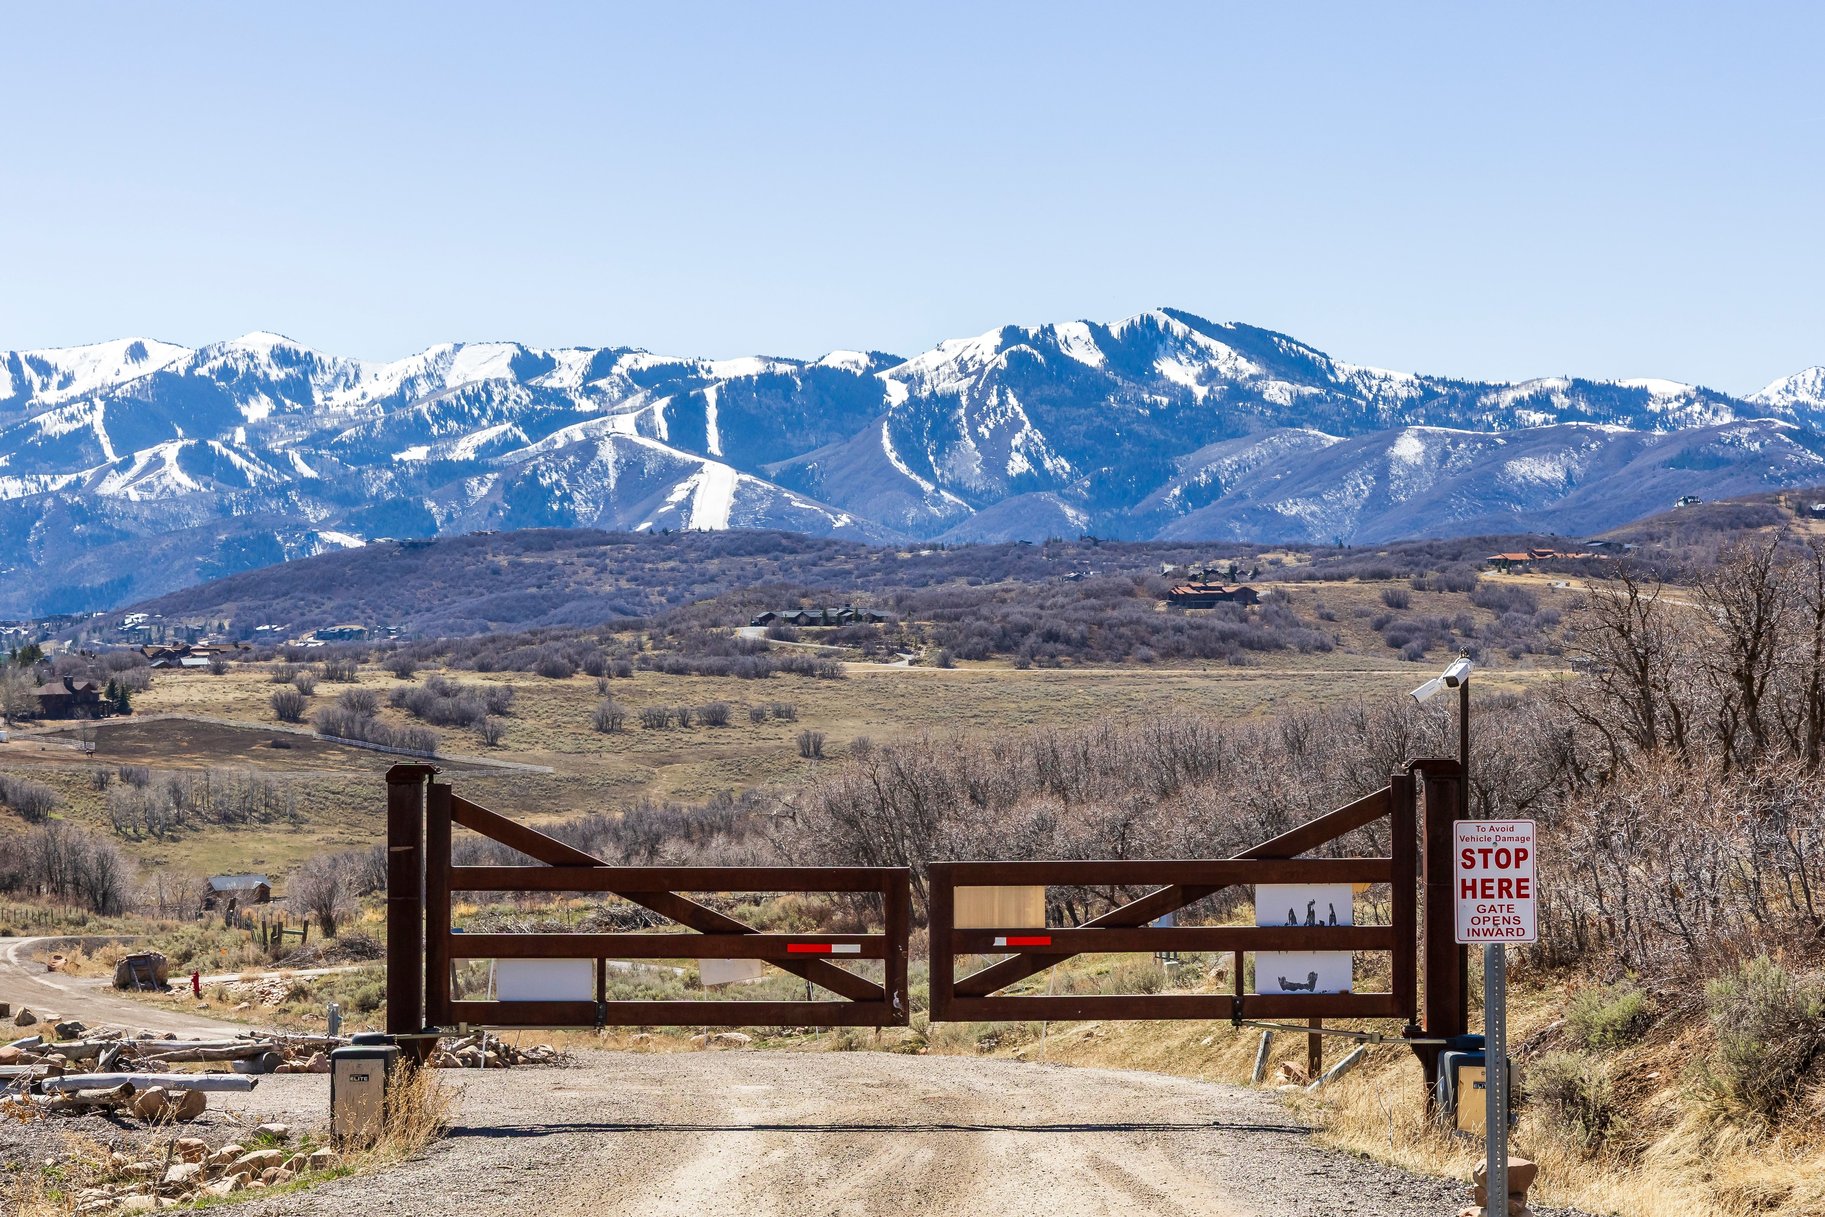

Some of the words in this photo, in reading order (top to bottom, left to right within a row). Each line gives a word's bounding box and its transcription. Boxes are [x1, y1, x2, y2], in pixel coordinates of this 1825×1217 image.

[1495, 834, 1531, 843] Damage
[1461, 848, 1528, 869] STOP
[1461, 878, 1530, 899] HERE
[1476, 904, 1515, 913] GATE
[1471, 916, 1521, 925] OPENS
[1467, 927, 1525, 937] INWARD
